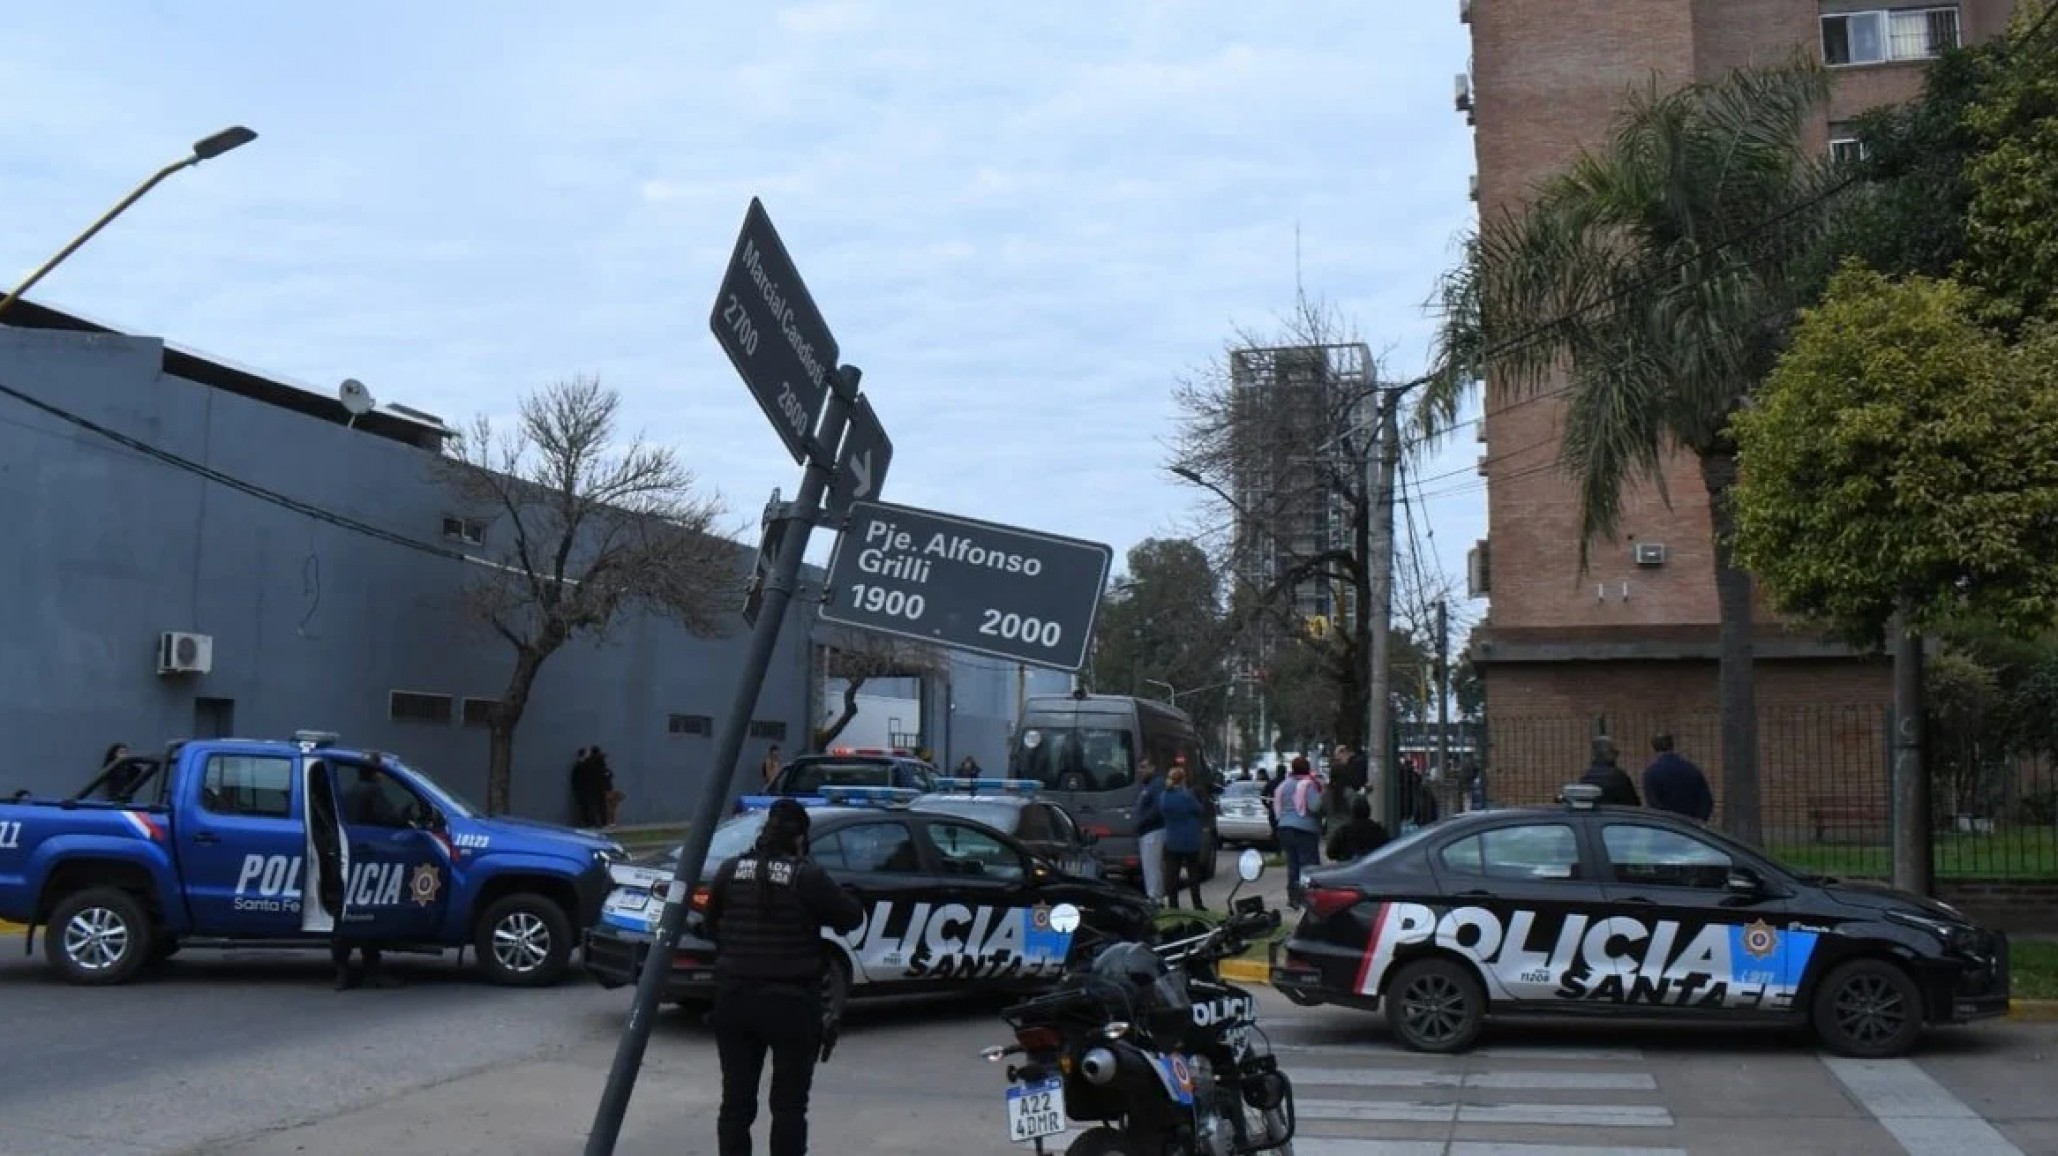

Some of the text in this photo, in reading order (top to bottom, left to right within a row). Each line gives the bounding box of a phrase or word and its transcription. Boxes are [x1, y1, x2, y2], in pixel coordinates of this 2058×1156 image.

[743, 239, 786, 321] Marcial
[723, 294, 758, 356] 2700
[777, 380, 809, 437] 2600
[858, 548, 933, 584] Grilli
[865, 519, 1042, 577] Pje. Alfonso
[851, 583, 926, 621] 1900
[979, 608, 1062, 648] 2000
[234, 897, 301, 913] Santa Fe
[1364, 901, 1732, 996] POLICIA
[1016, 1111, 1060, 1137] 4DMR
[1020, 1092, 1052, 1116] A22
